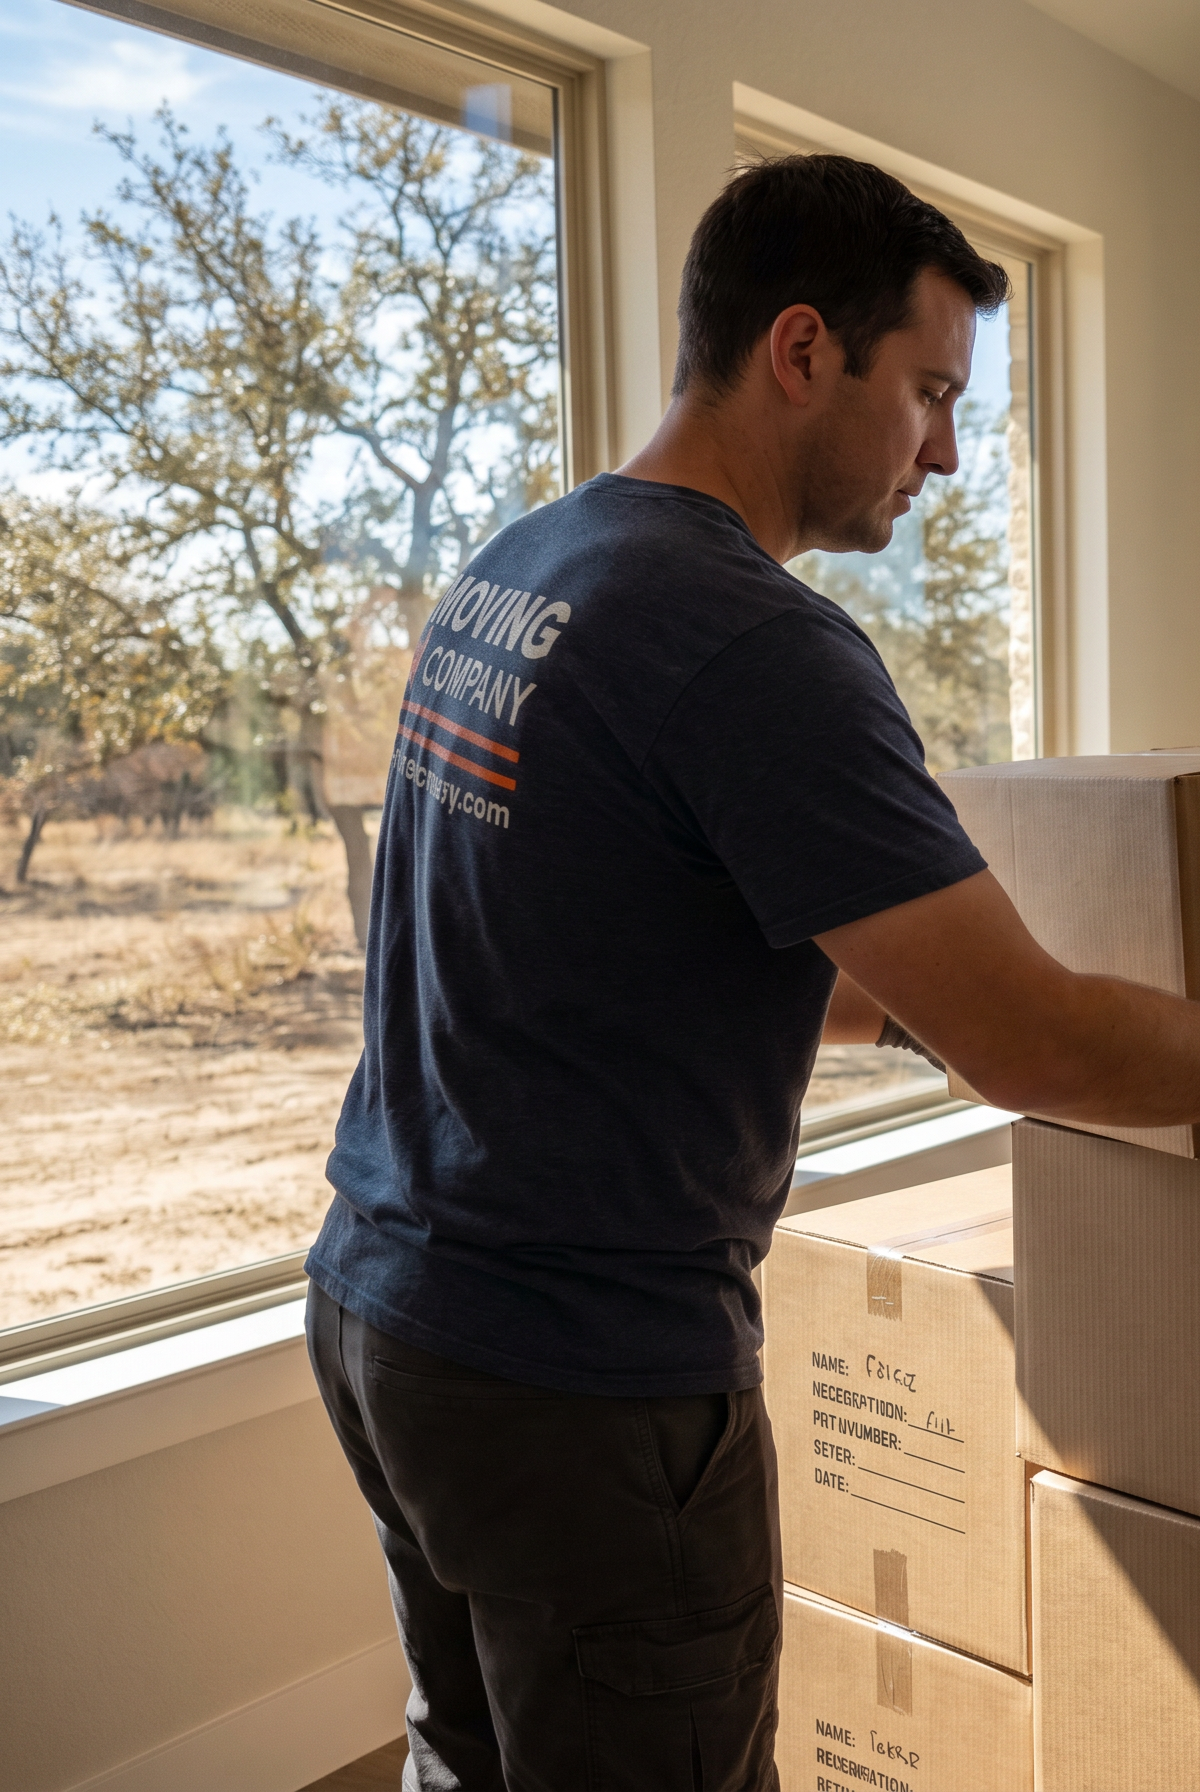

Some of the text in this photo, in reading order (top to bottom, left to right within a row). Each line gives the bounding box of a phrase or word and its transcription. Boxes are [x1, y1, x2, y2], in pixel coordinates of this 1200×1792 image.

[430, 573, 572, 660] MOVING
[422, 645, 538, 727] COMPANY
[812, 1351, 849, 1376] NAME:
[814, 1439, 855, 1466] SETER:
[815, 1467, 849, 1493] DATE:
[816, 1718, 856, 1748] NAME:
